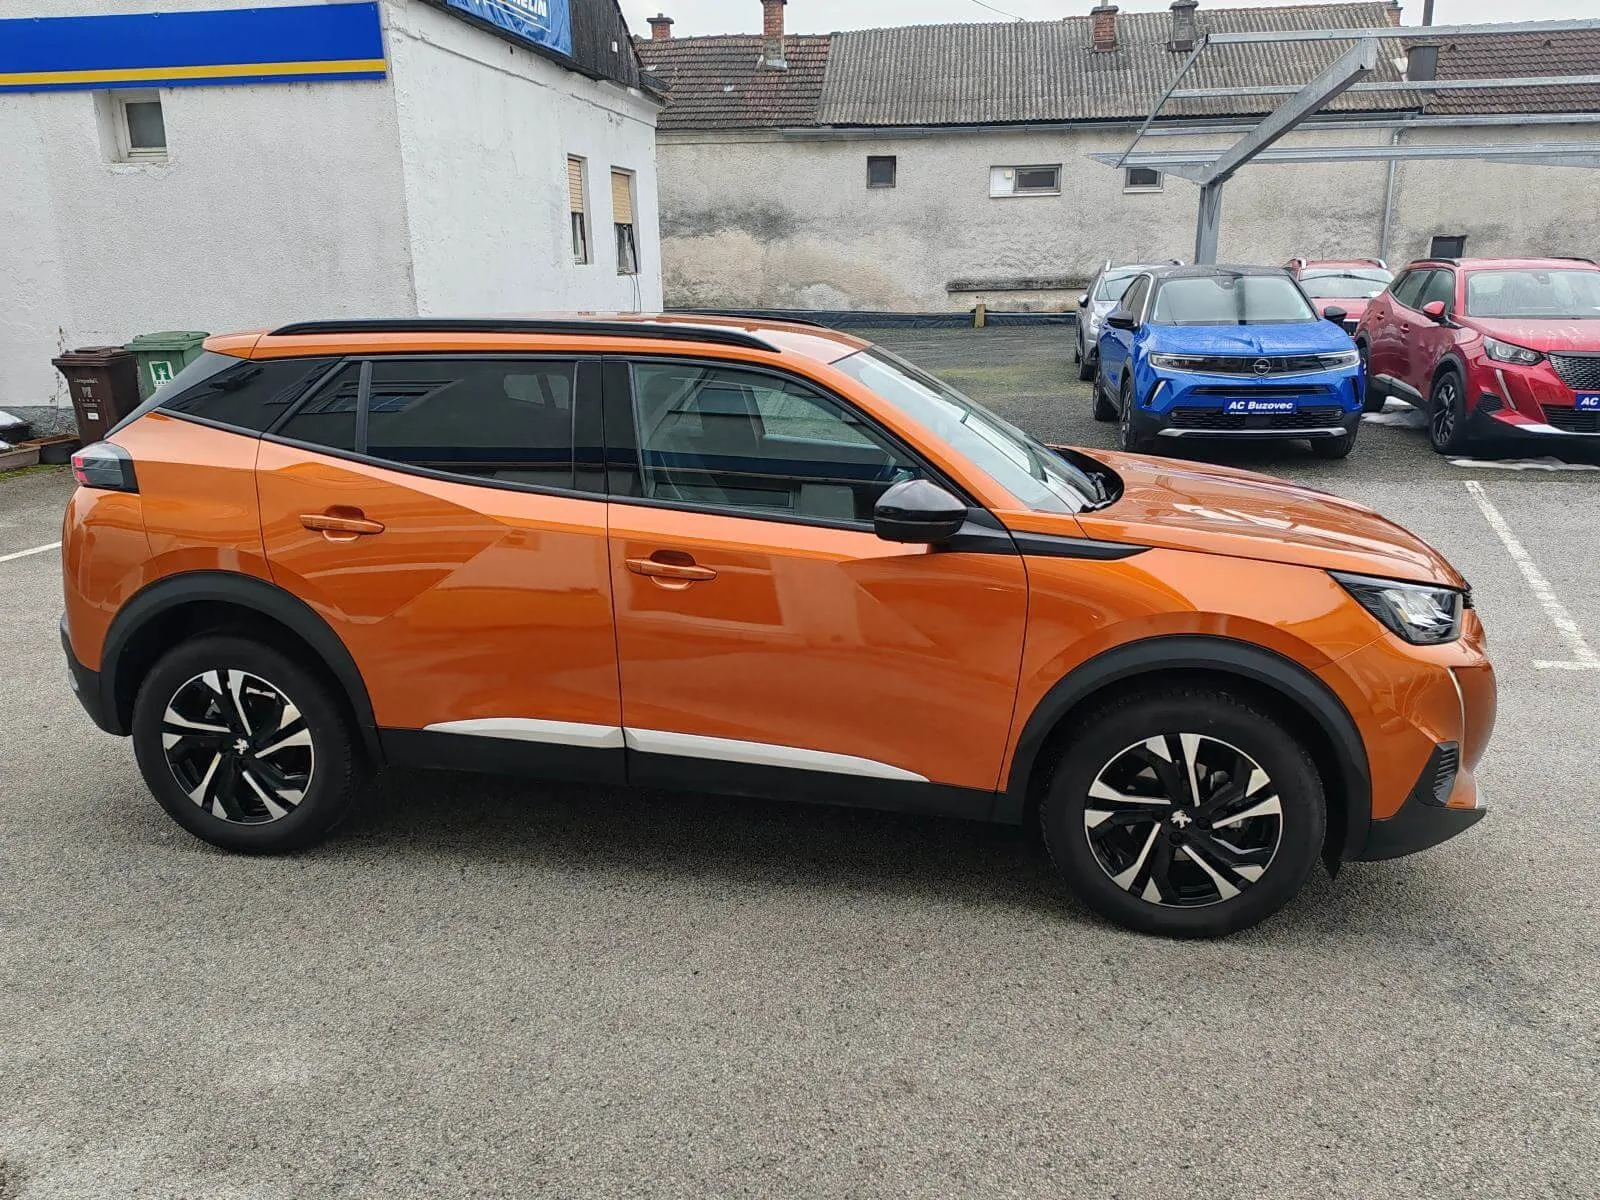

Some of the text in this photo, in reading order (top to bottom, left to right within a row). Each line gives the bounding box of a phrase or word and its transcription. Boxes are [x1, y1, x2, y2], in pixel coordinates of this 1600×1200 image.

[1228, 401, 1294, 410] AC Buzovec
[1581, 397, 1599, 406] AC
